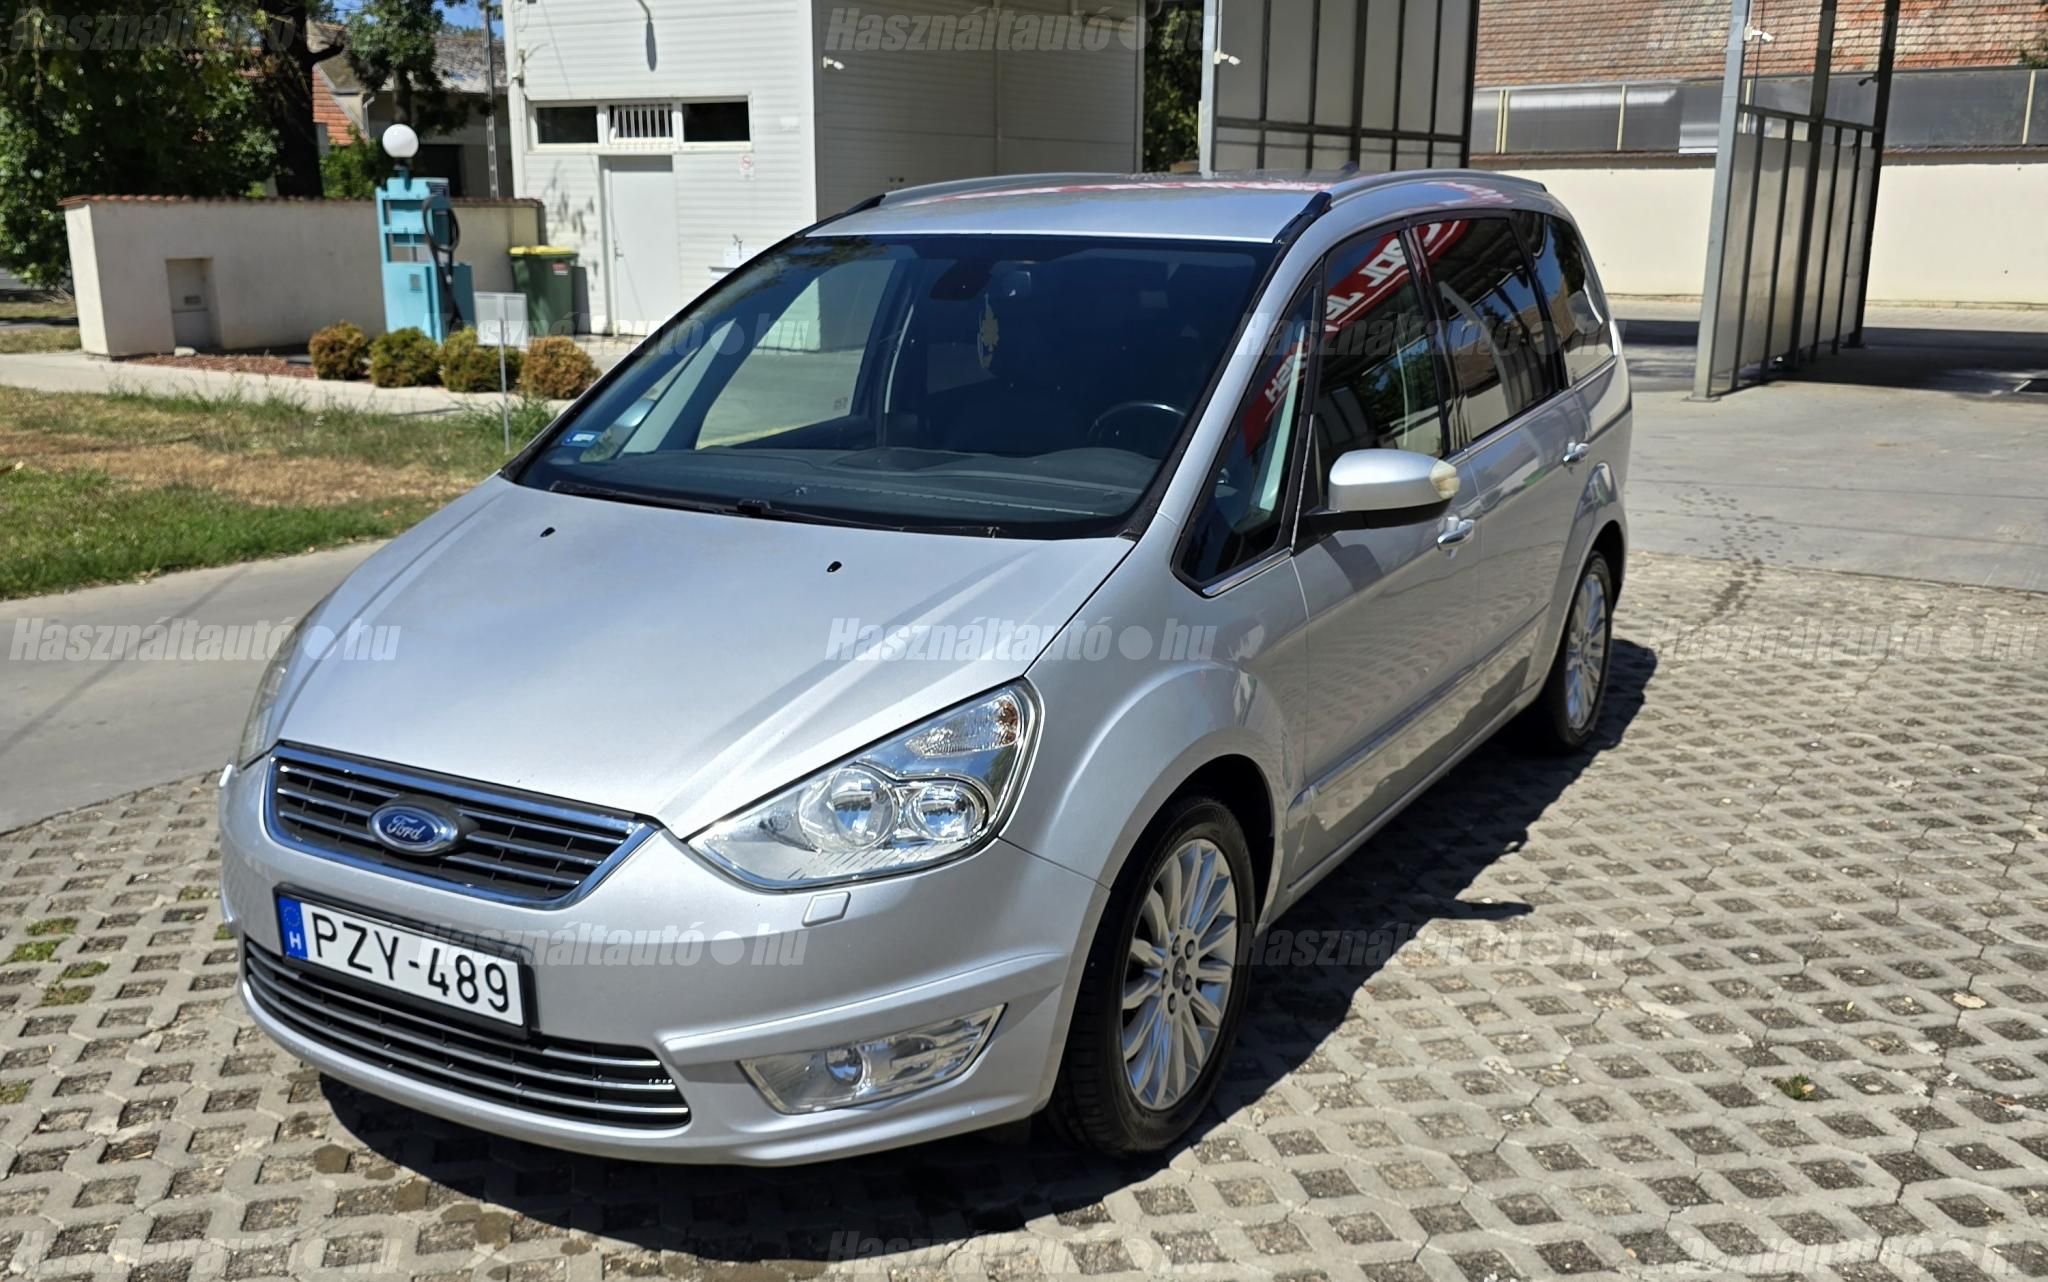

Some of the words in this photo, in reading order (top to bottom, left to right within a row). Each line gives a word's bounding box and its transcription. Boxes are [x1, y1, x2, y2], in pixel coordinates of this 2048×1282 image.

[387, 815, 427, 840] Ford
[289, 930, 303, 951] H
[311, 911, 510, 1013] PZY-489
